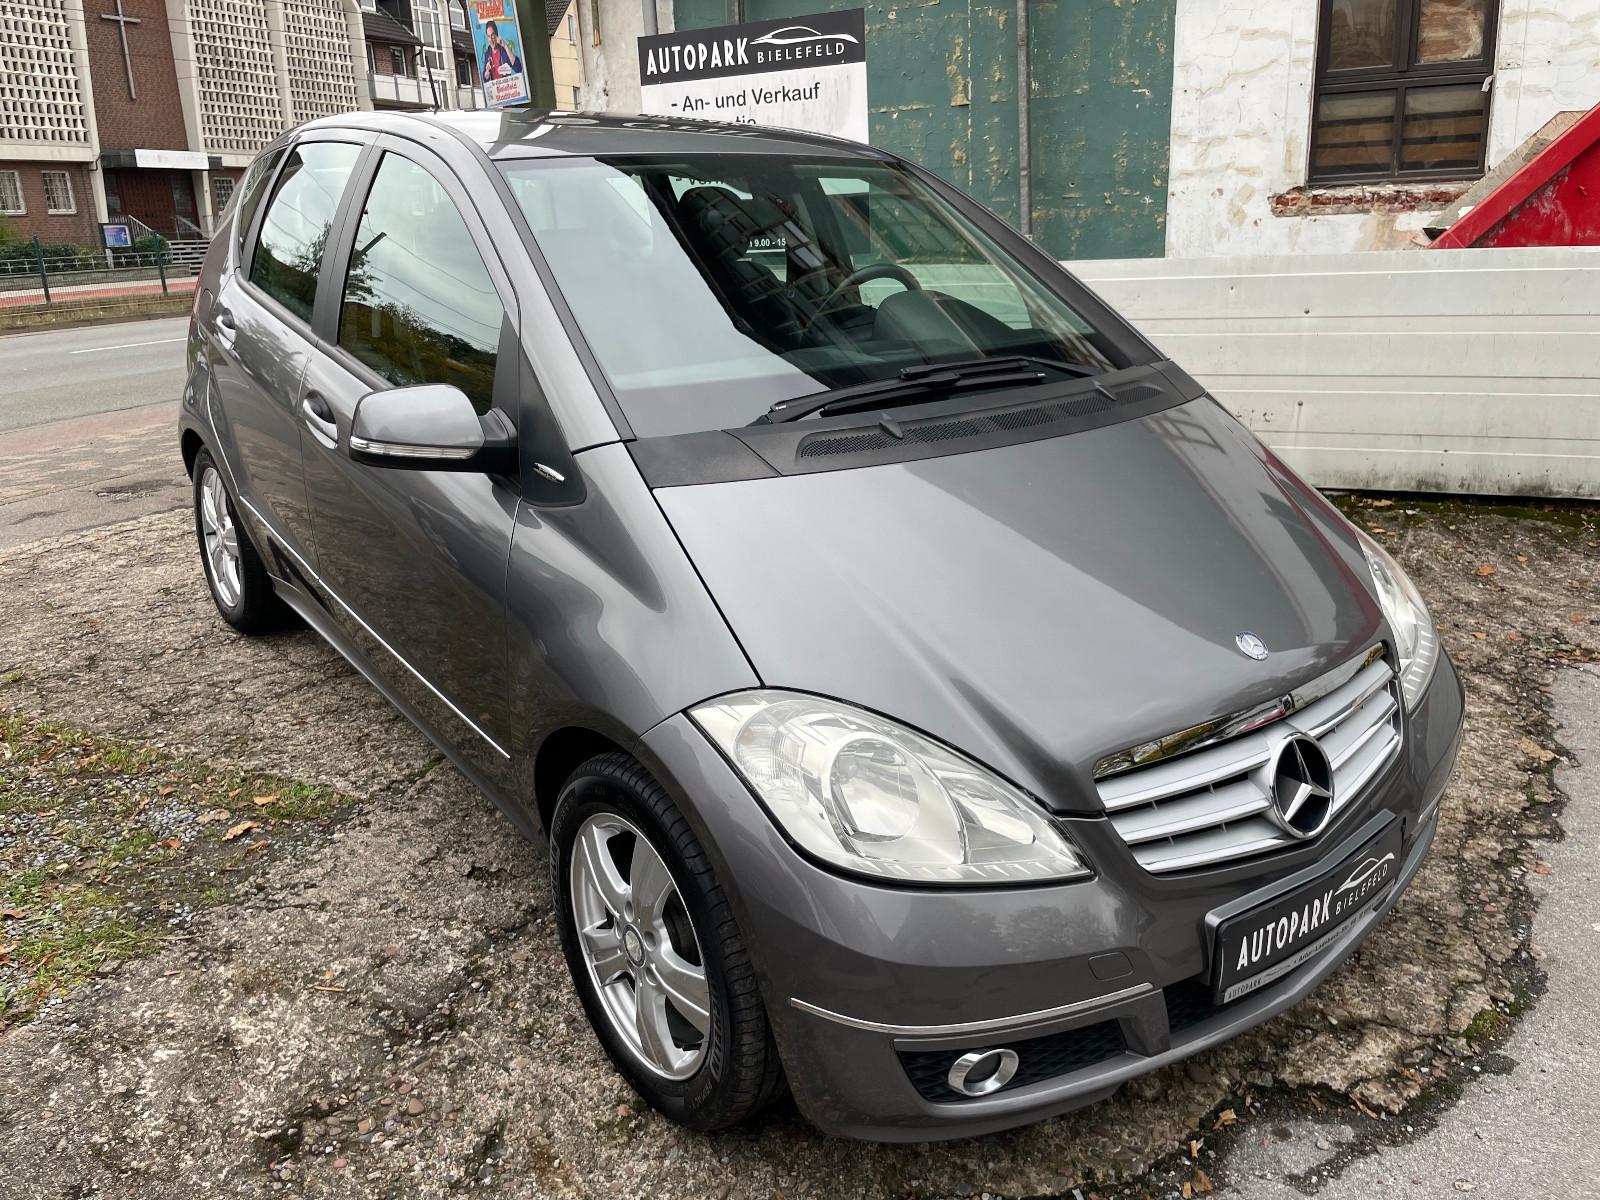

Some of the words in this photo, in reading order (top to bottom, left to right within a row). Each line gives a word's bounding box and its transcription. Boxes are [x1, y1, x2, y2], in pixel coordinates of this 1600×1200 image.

[646, 38, 749, 76] AUTOPARK
[757, 42, 845, 64] BIELEFELD
[682, 96, 711, 112] An-
[715, 90, 747, 108] und
[751, 82, 820, 105] Verkauf
[754, 238, 771, 247] 9.00
[1236, 889, 1333, 971] AUTOPARK
[1335, 863, 1388, 916] BIELEFELD
